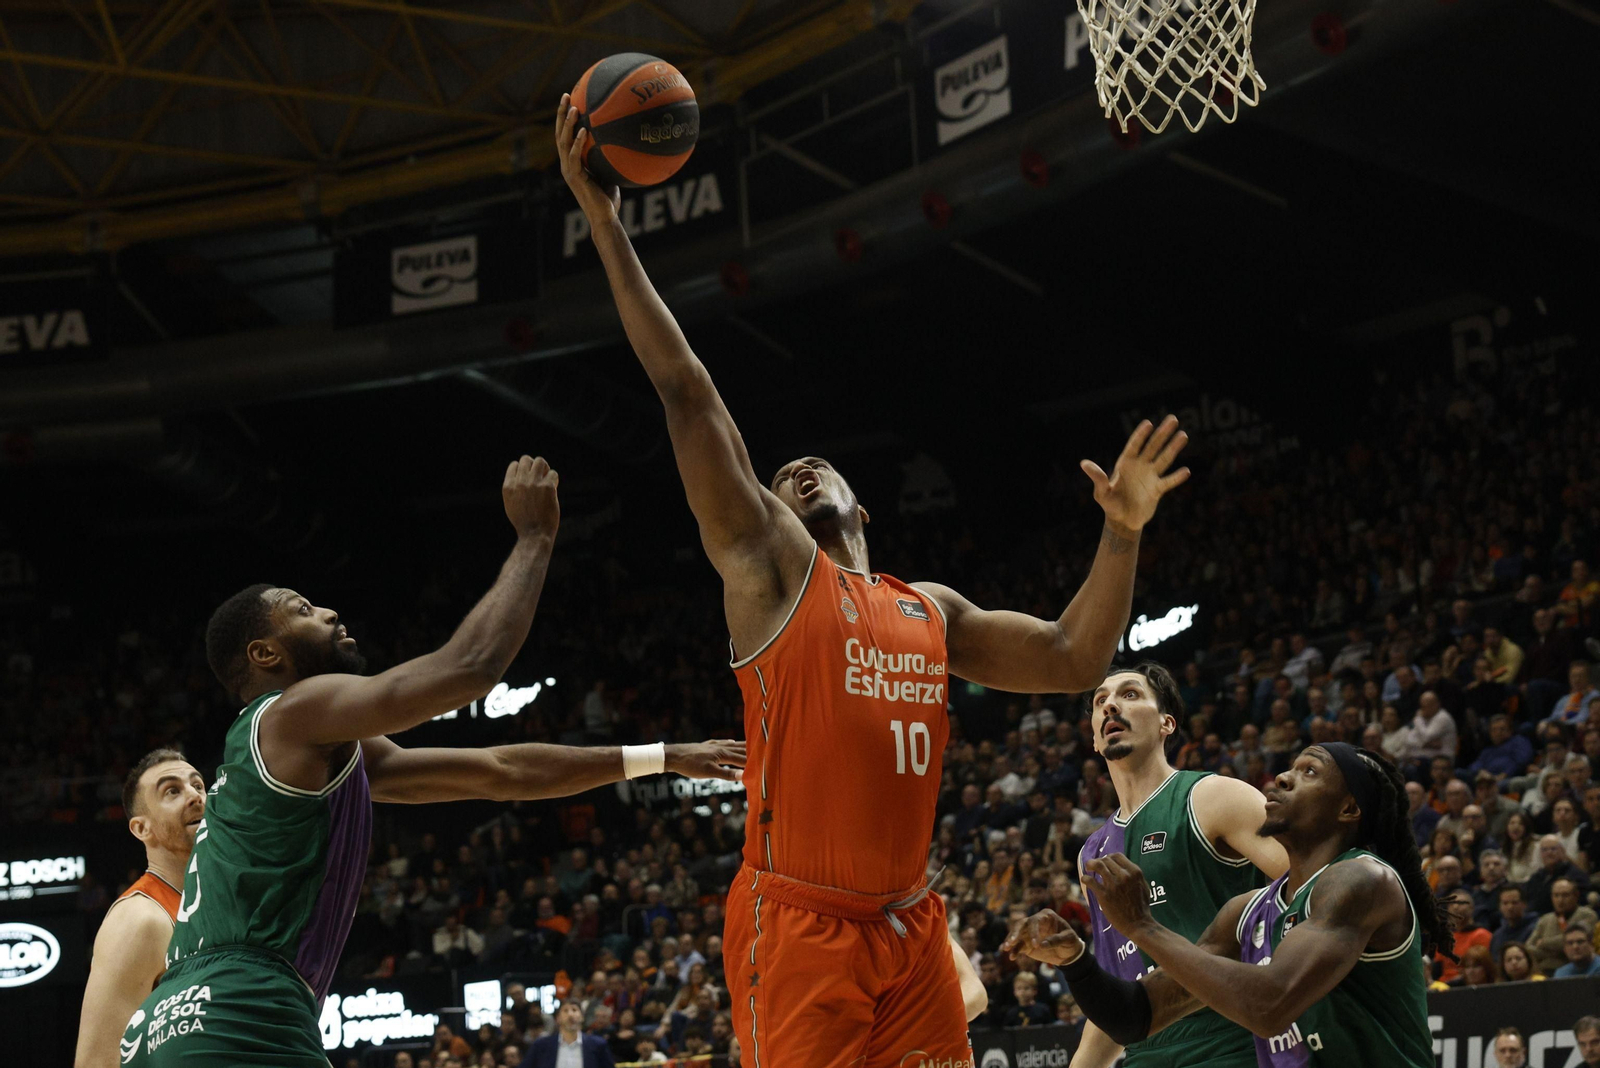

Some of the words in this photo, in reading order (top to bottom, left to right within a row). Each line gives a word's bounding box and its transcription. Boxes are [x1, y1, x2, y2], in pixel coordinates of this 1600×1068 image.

[940, 50, 1003, 98] PULEVA
[563, 173, 723, 258] PLEVA
[398, 247, 471, 274] PULEVA
[845, 637, 925, 674] Cultura
[927, 662, 946, 676] del
[845, 666, 944, 704] Esfuerzo
[890, 719, 931, 776] 10
[10, 856, 86, 885] BOSCH
[148, 1013, 168, 1037] DEL
[169, 1002, 207, 1021] SOL
[153, 985, 212, 1017] COSTA
[147, 1018, 205, 1055] MÁLAGA
